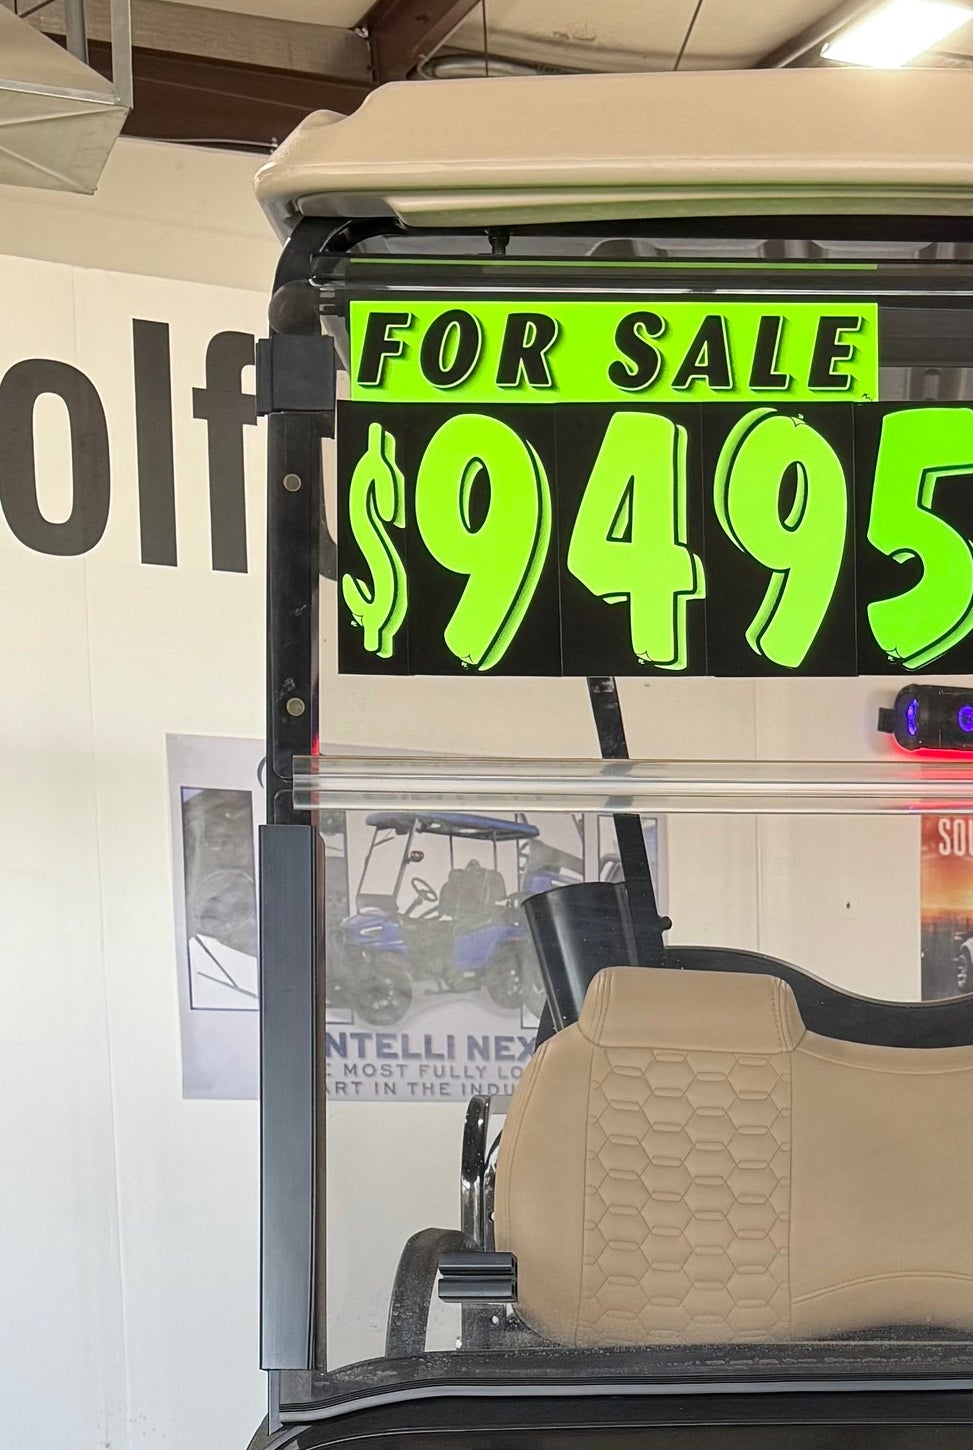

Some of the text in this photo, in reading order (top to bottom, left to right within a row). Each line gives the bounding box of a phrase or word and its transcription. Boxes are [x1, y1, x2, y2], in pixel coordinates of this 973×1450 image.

[357, 310, 863, 390] FOR SALE
[326, 1032, 455, 1061] NTELLI
[343, 1063, 408, 1078] MOST
[419, 1064, 487, 1080] FULLY
[374, 1081, 397, 1096] IN
[407, 1081, 451, 1096] THE
